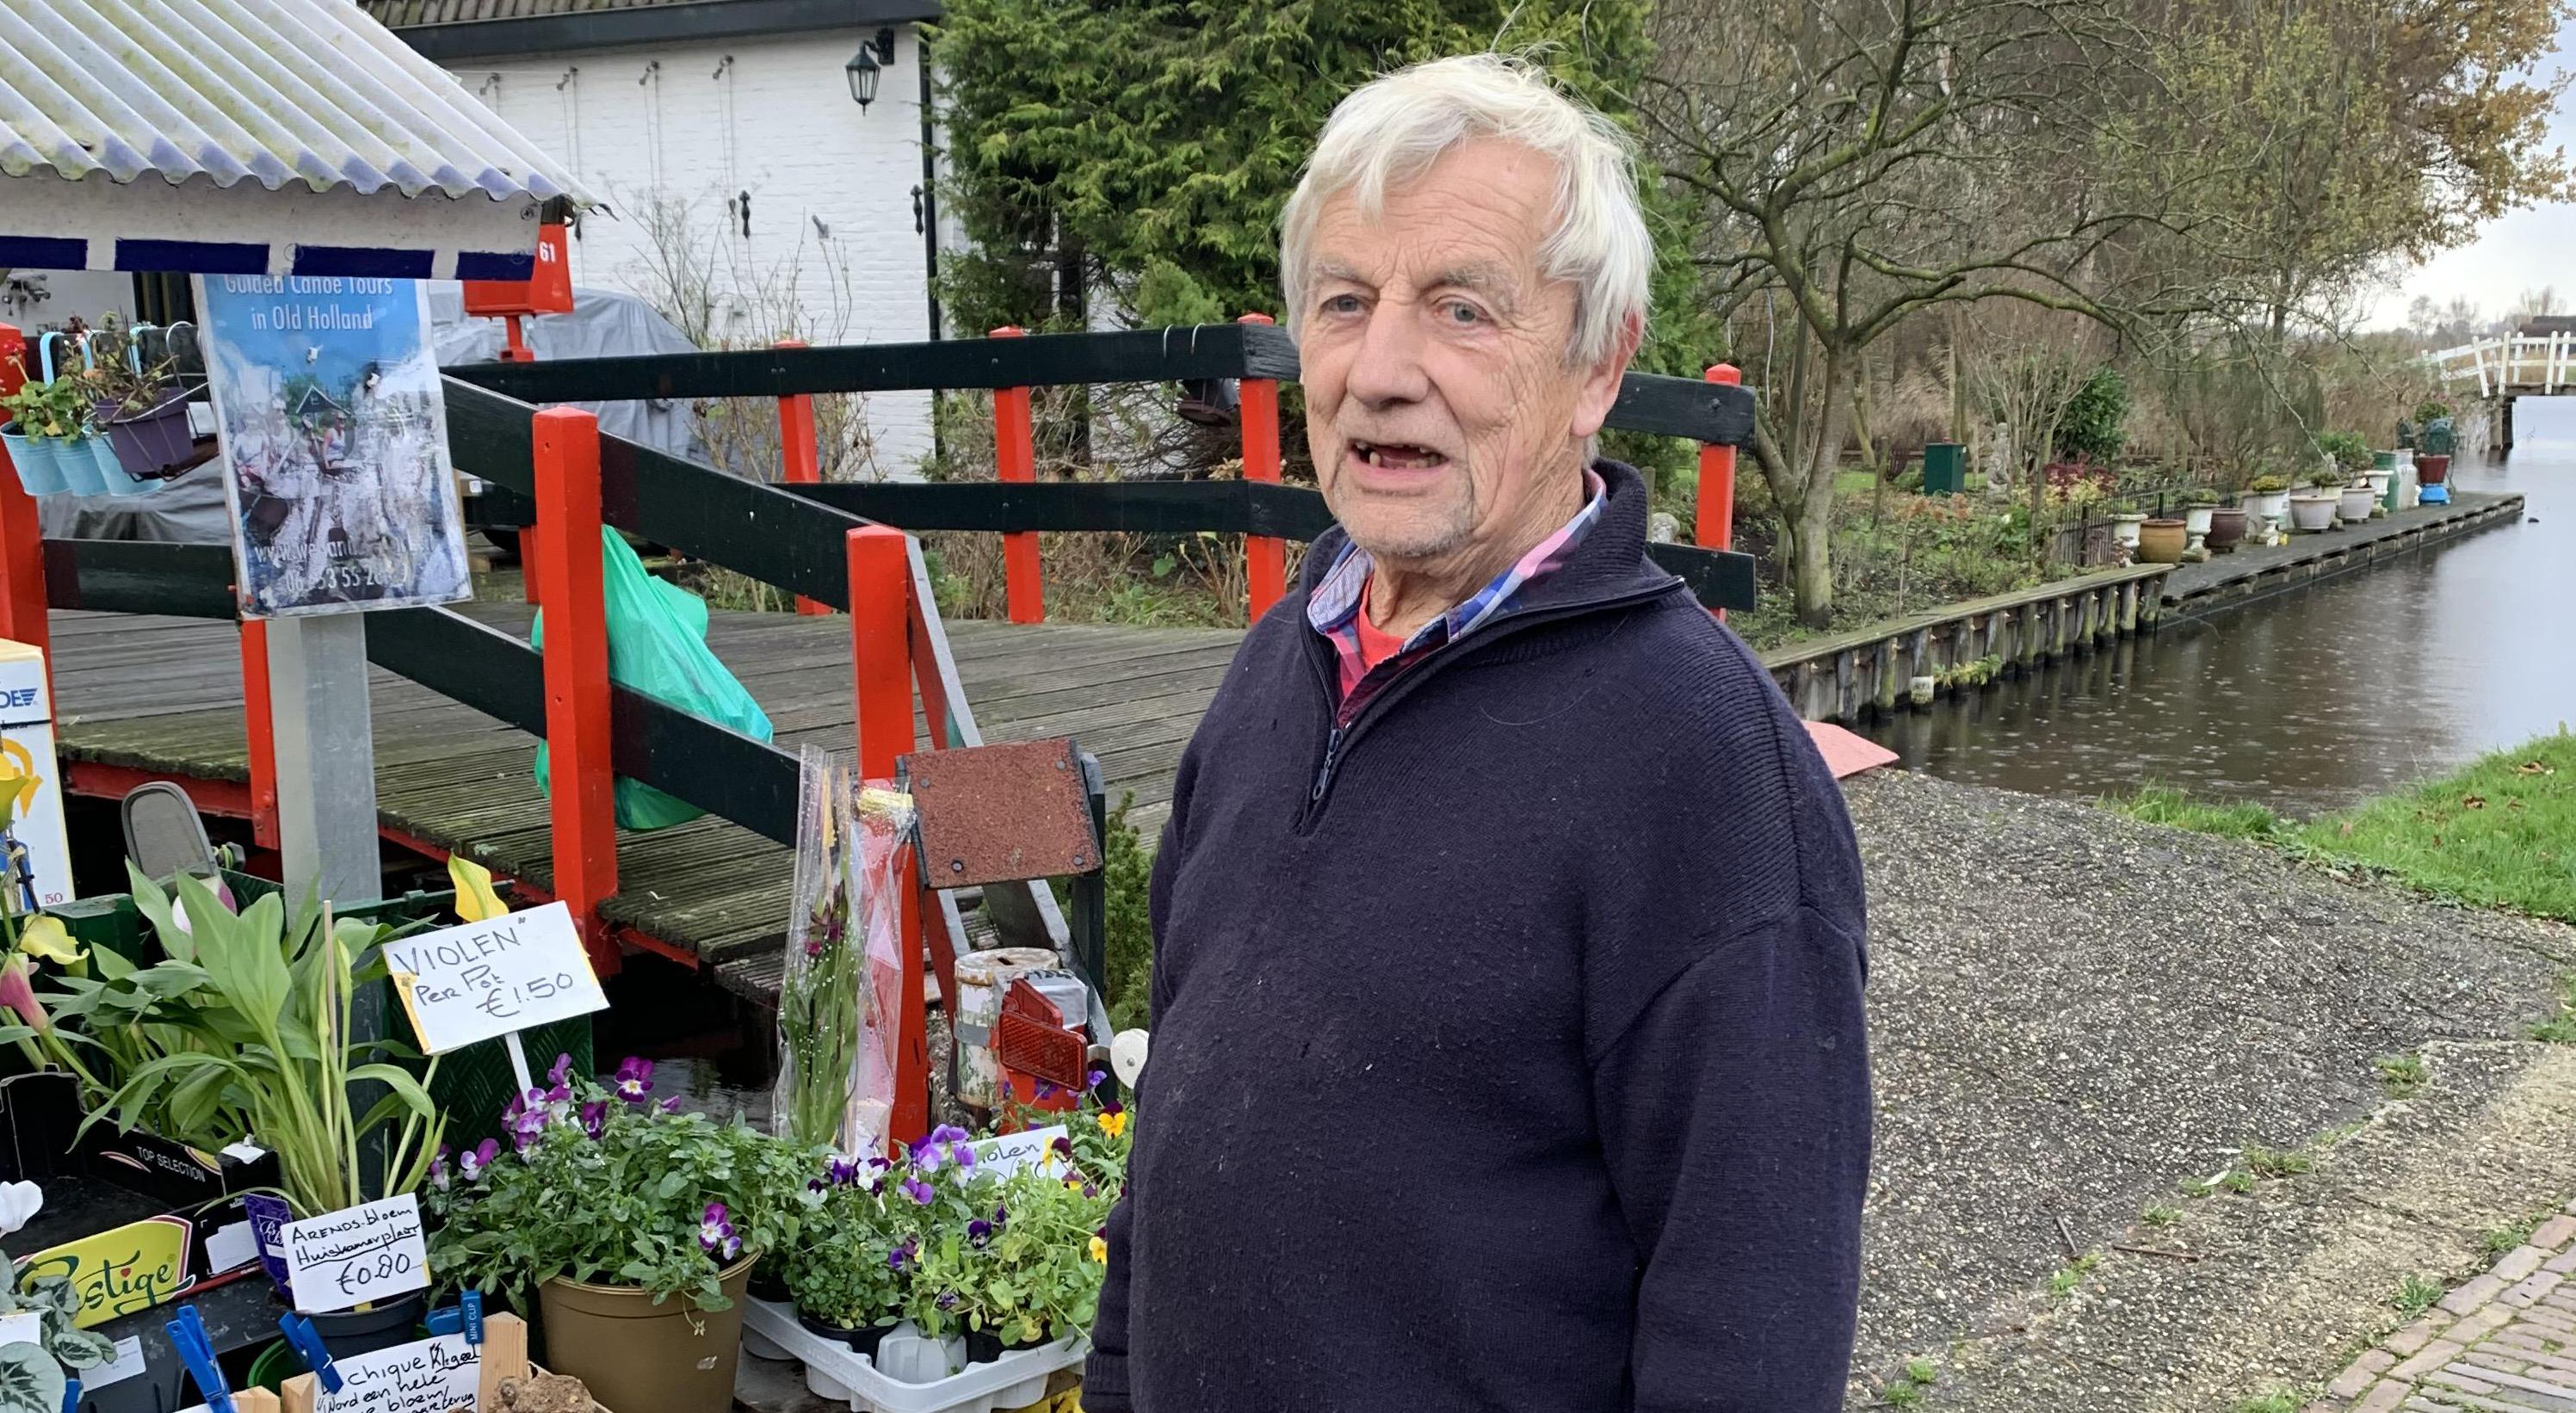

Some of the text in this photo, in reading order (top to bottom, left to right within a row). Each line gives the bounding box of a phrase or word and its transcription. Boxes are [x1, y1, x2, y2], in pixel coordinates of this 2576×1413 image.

[539, 241, 556, 262] 61
[224, 275, 284, 293] Guided
[291, 275, 343, 294] Canoe
[251, 304, 373, 330] in Old Holland
[44, 892, 64, 904] 50
[136, 1145, 206, 1183] TOP SELECTION
